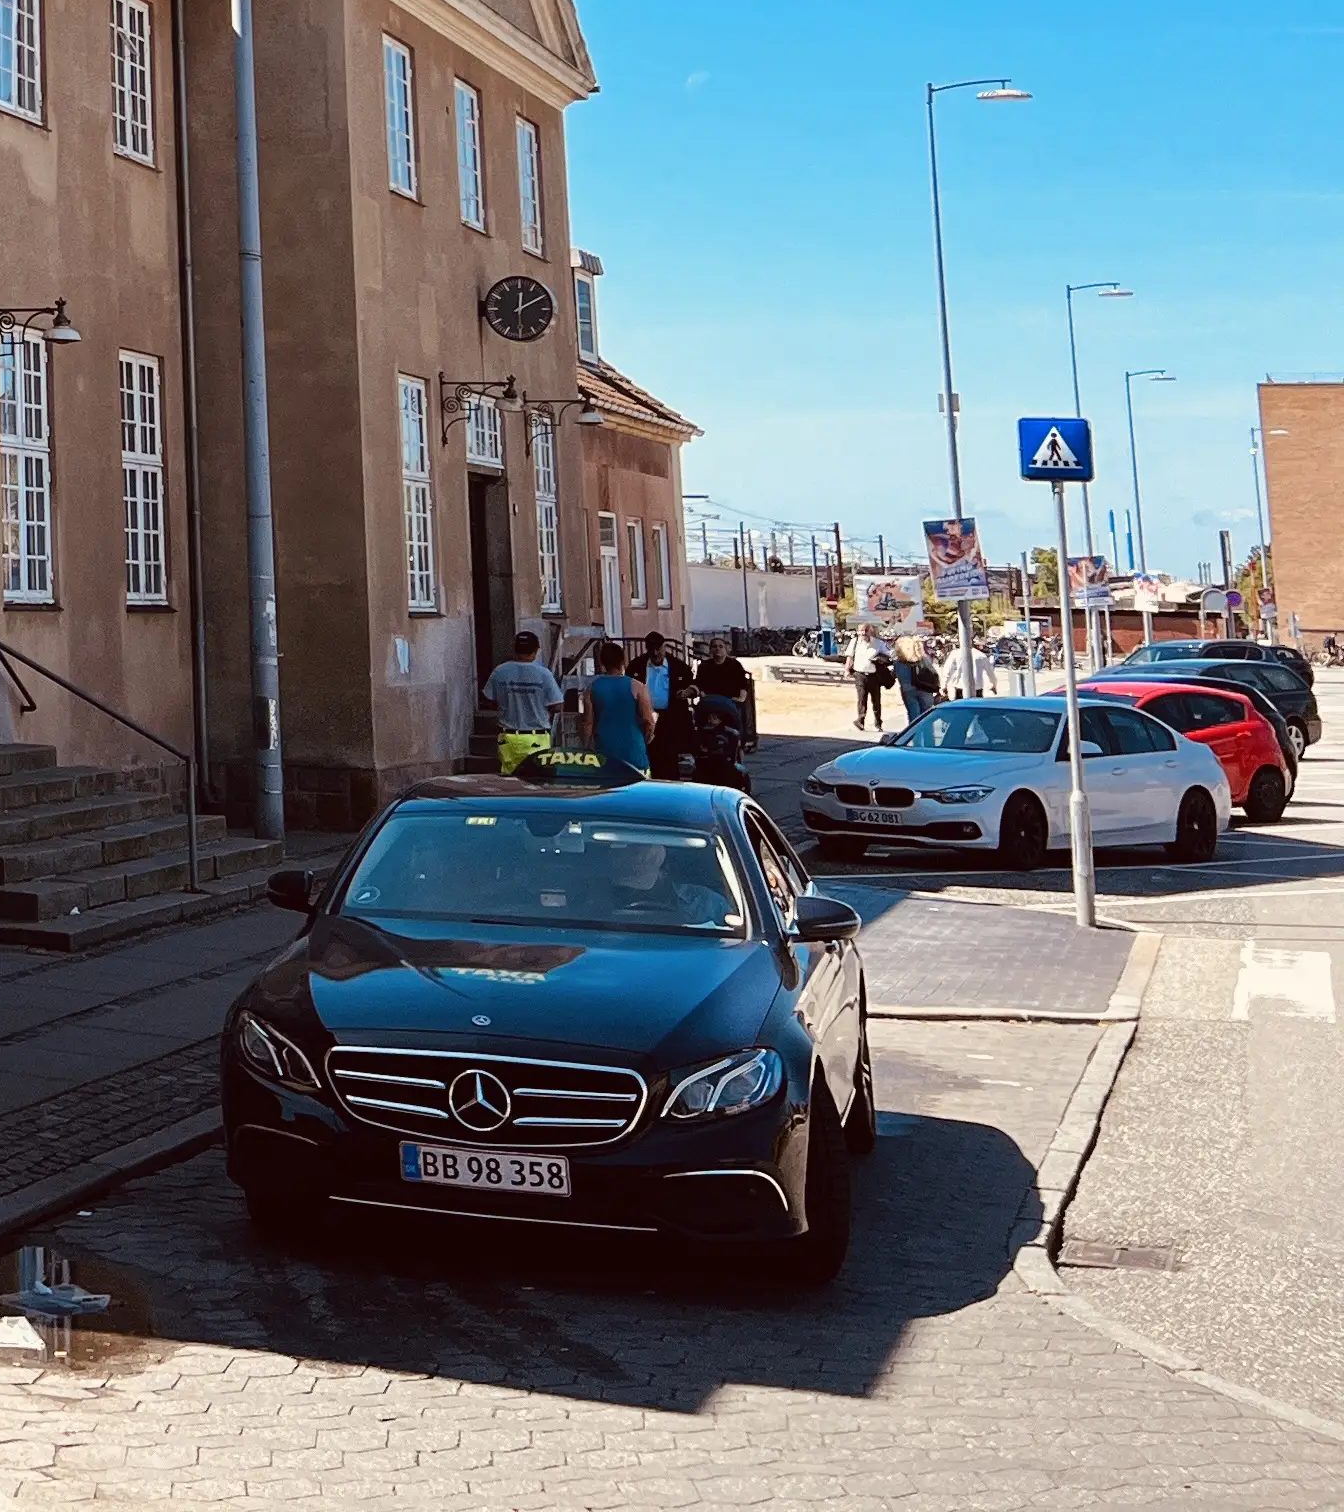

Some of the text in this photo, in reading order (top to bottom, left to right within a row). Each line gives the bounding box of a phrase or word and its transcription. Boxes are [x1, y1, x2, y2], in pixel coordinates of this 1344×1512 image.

[537, 751, 602, 769] TAXA
[868, 812, 880, 823] 62
[882, 813, 899, 824] 081
[422, 1151, 564, 1189] BB 98 358
